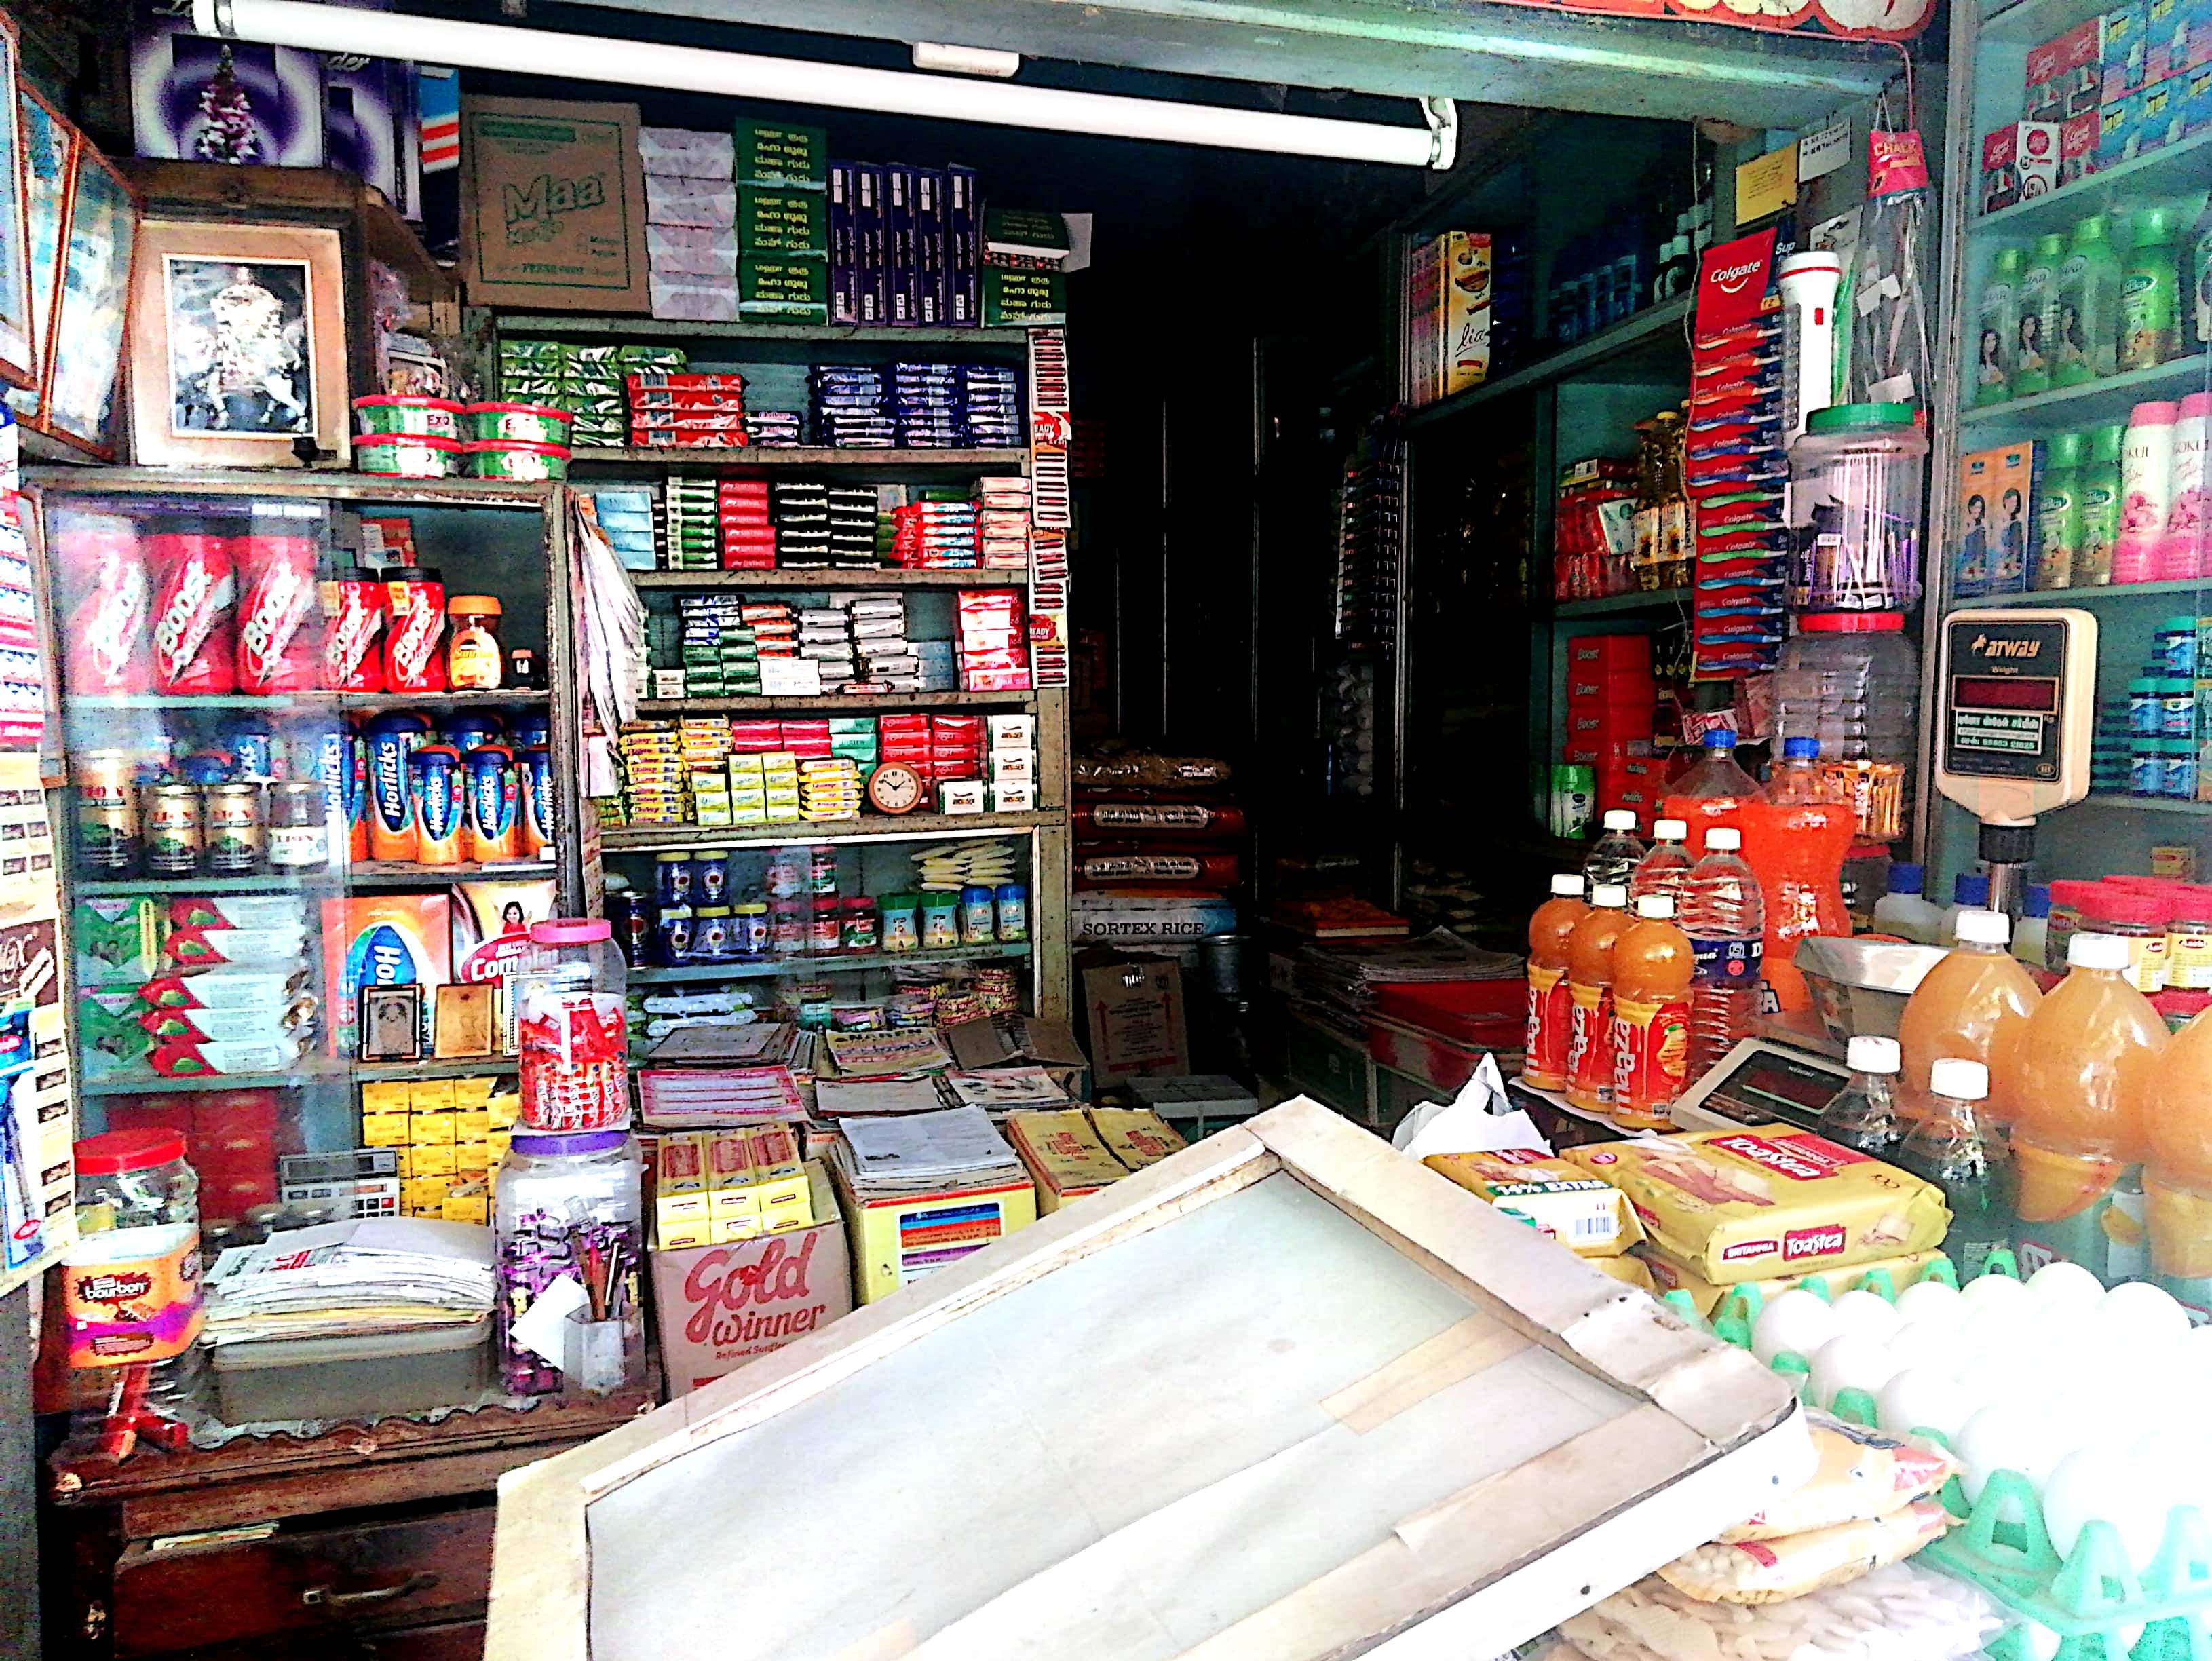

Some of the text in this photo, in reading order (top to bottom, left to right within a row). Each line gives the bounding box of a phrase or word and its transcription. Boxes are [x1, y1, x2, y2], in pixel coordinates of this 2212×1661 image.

[1710, 259, 1761, 282] Colgate
[1724, 514, 1754, 522] Colgate
[377, 741, 402, 818] Horlicks
[478, 776, 497, 830] Horlicks
[1082, 922, 1204, 935] SORTEX RICE
[1614, 1016, 1636, 1115] maaza
[1497, 1180, 1609, 1195] 14% EXTRA
[1727, 1242, 1776, 1259] BRITANNIA
[85, 1280, 148, 1299] bourbon
[685, 1232, 818, 1343] Gold
[716, 1345, 751, 1360] Refined
